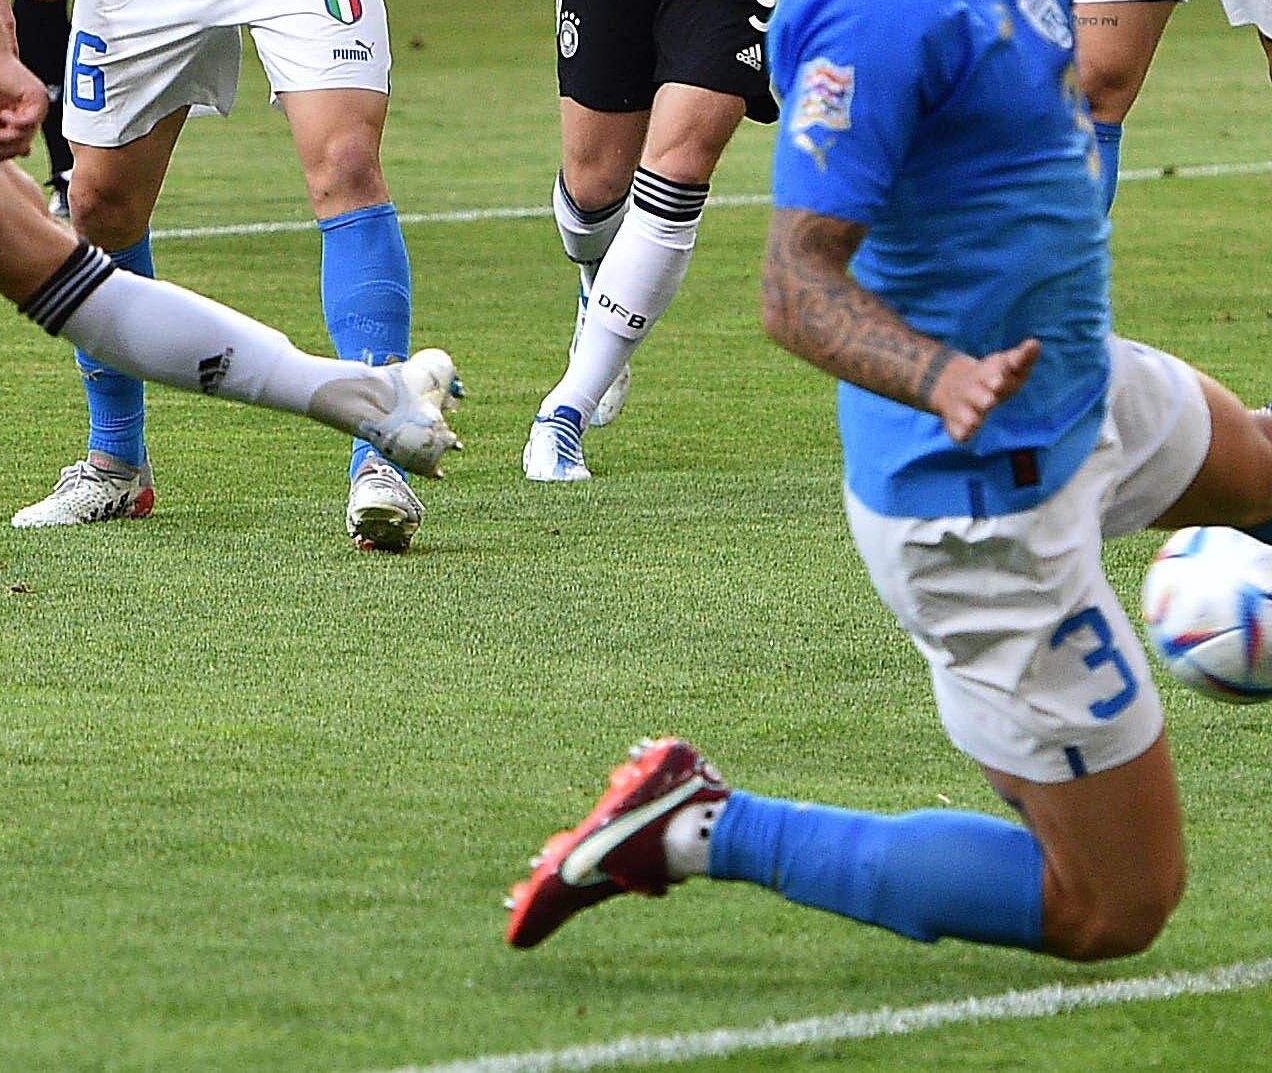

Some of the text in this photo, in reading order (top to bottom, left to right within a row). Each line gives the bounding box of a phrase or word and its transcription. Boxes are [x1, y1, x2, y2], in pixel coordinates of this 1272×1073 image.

[65, 30, 108, 112] 6
[332, 47, 368, 63] PUMA
[598, 293, 648, 331] DFB
[1050, 606, 1140, 722] 3
